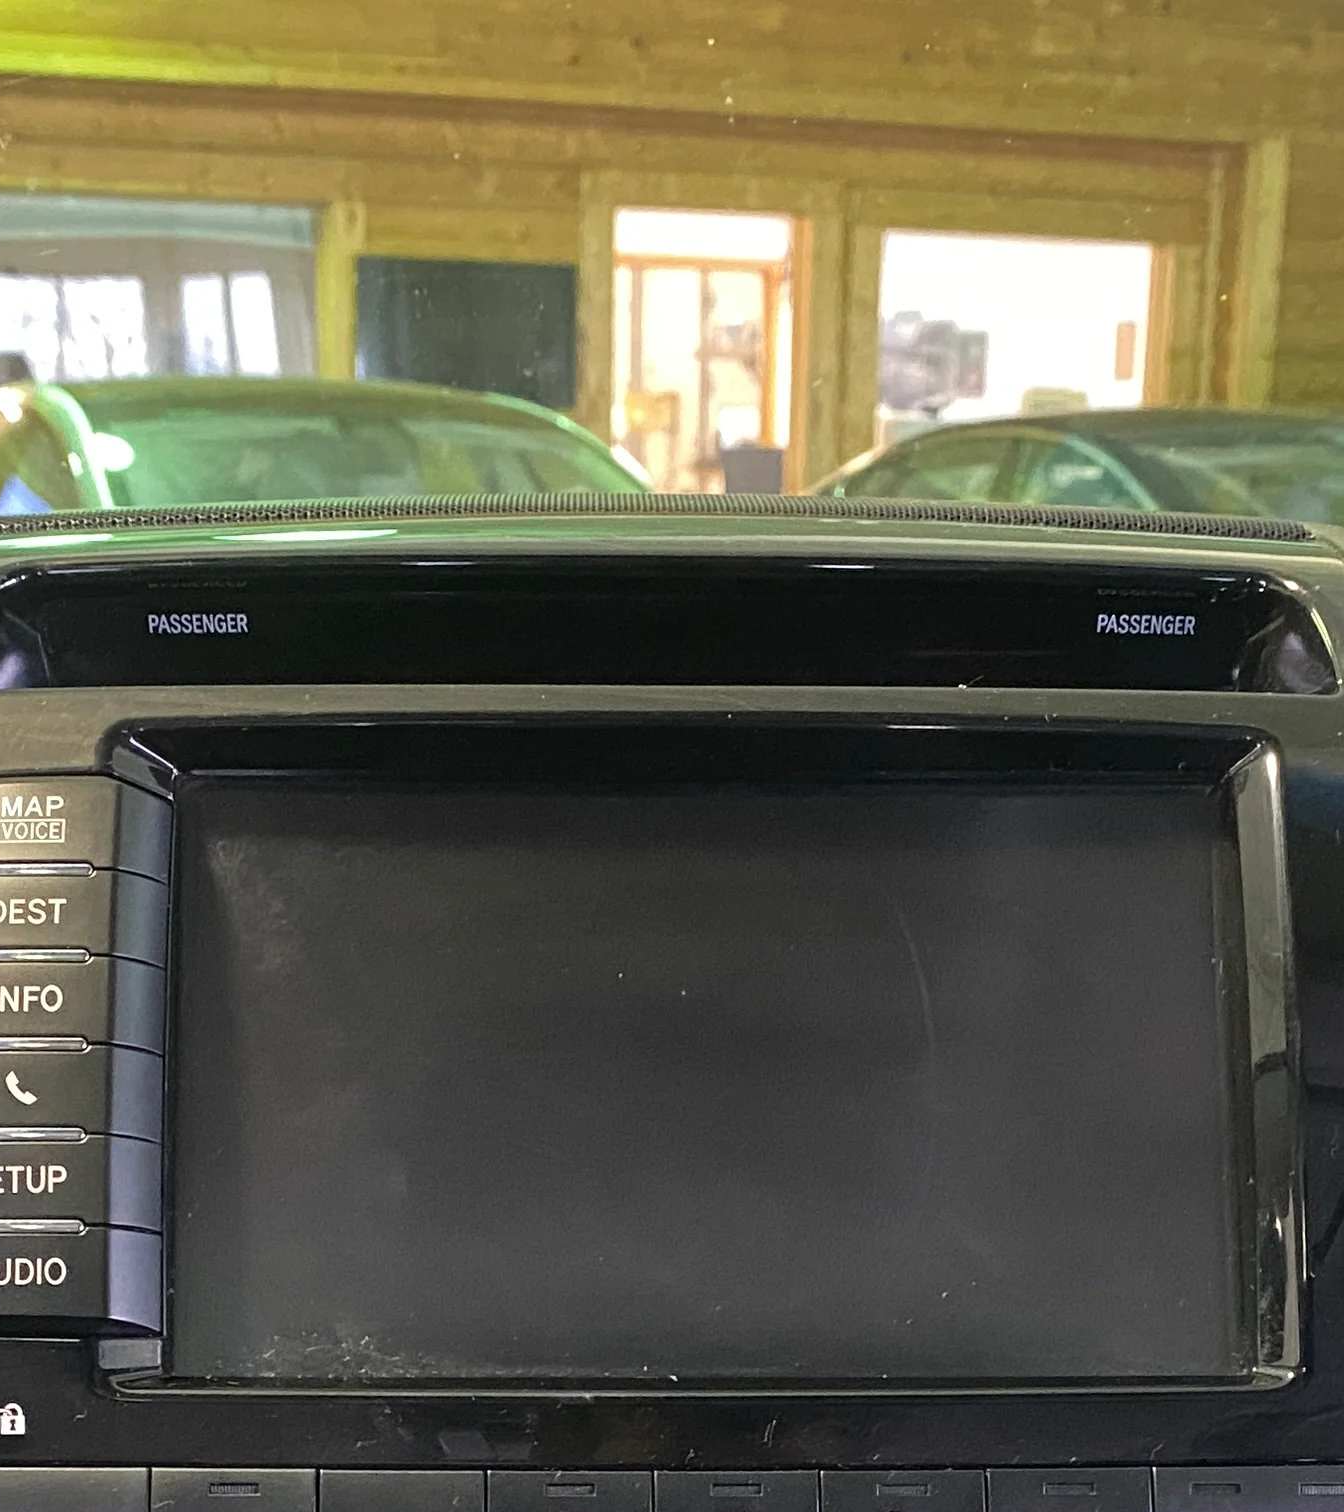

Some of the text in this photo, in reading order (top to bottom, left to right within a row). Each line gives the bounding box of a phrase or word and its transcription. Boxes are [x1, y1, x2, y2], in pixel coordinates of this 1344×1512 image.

[147, 613, 248, 634] PASSENGER
[1096, 613, 1196, 636] PASSENGER
[1, 796, 64, 817] MAP
[2, 822, 60, 840] VOICE
